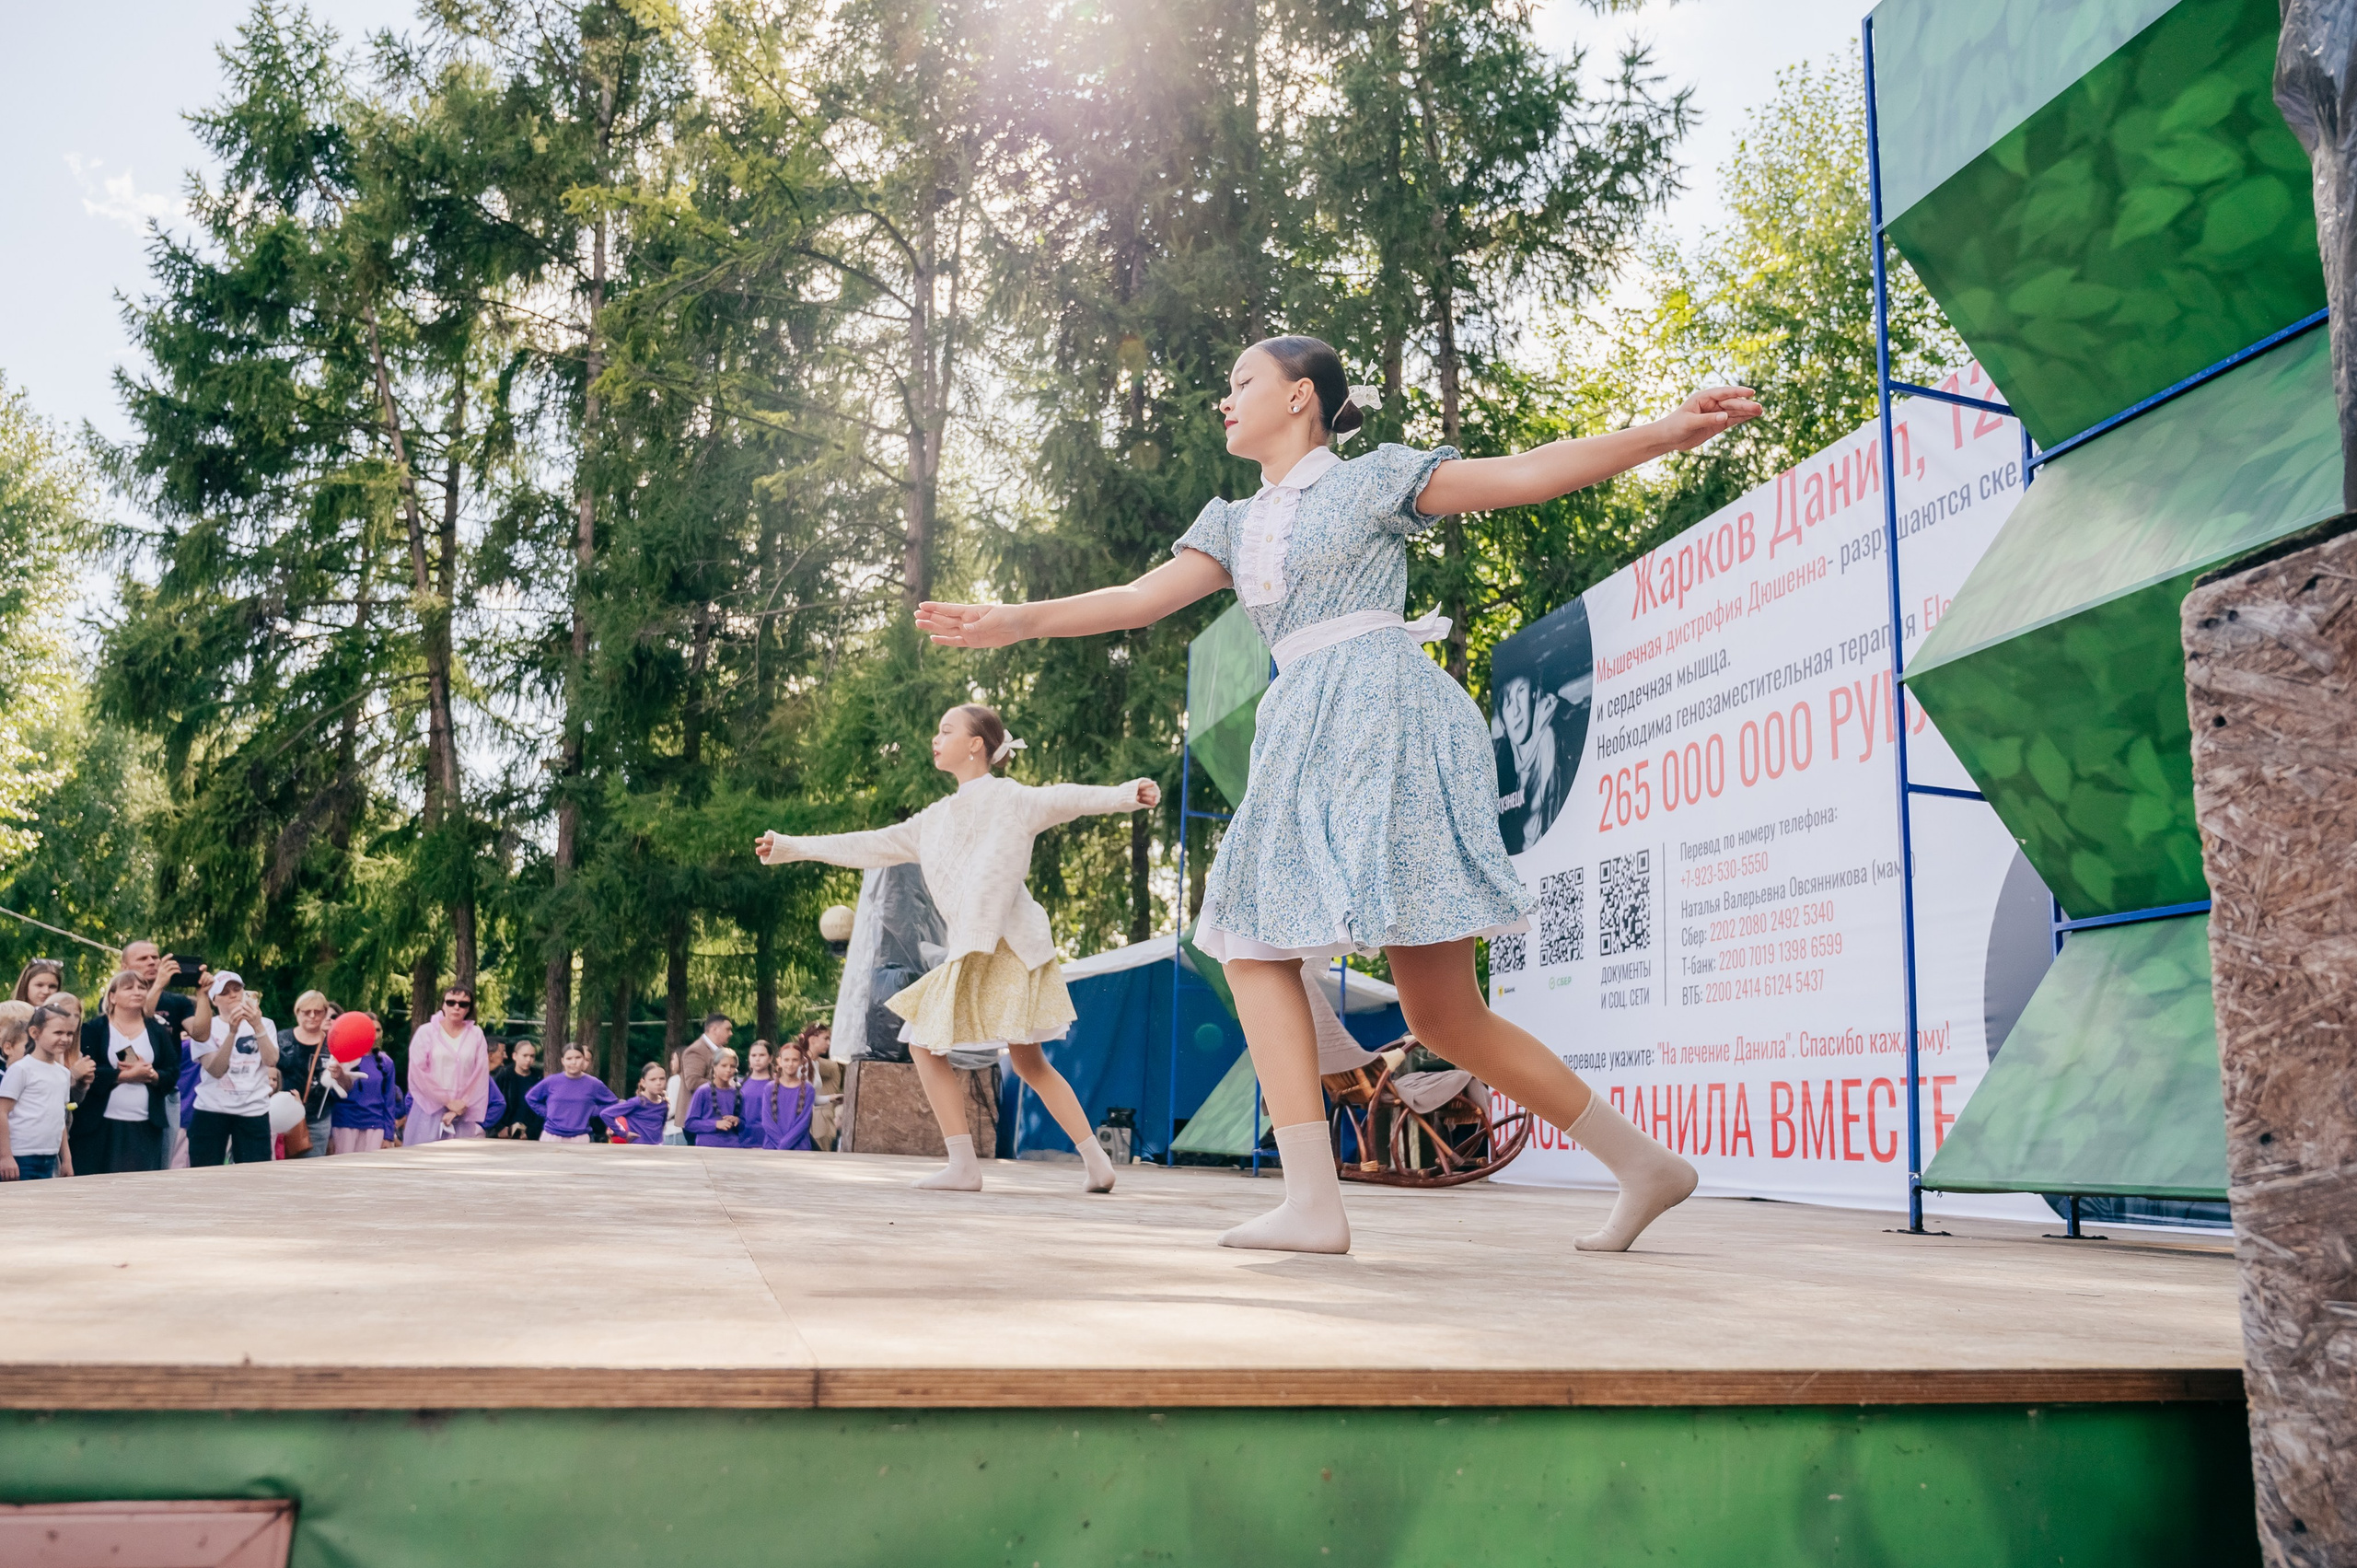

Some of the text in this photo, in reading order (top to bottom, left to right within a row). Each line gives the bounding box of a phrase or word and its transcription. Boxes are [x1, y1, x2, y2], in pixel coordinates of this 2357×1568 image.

[1631, 511, 1756, 621] Жарков
[1596, 636, 1662, 684] Мышечная
[1666, 597, 1743, 656] дистрофия
[1747, 555, 1834, 617] Дюшенна-
[1596, 648, 1731, 723] и сердечная мышца.
[1597, 714, 1672, 761] Необходима
[1676, 646, 1834, 728] генозаместительная
[1839, 614, 1916, 665] терапя
[1598, 760, 1650, 833] 265
[1662, 733, 1724, 812] 000
[1739, 701, 1813, 787] 000
[1498, 788, 1525, 815] УЗНЕЦК
[1680, 807, 1838, 862] Перевод по номеру телефона:
[1681, 852, 1769, 889] +7-923-530-5550
[1681, 898, 1721, 919] Наталья
[1724, 883, 1786, 911] Валерьевна
[1789, 866, 1868, 898] Овсянникова
[1681, 900, 1834, 948] Сбер: 2202 2080 2492 5340
[1600, 959, 1651, 986] ДОКУМЕНТЫ
[1682, 932, 1842, 976] Т-банк: 2200 7019 1398 6599
[1601, 987, 1650, 1009] И СОЦ. СЕТИ
[1682, 969, 1824, 1005] ВТБ: 2200 2414 6124 5437
[1563, 1051, 1606, 1073] переводе
[1609, 1048, 1655, 1072] укажите:
[1657, 1041, 1677, 1065] "На
[1680, 1043, 1730, 1064] лечение
[1800, 1027, 1864, 1058] Спасибо
